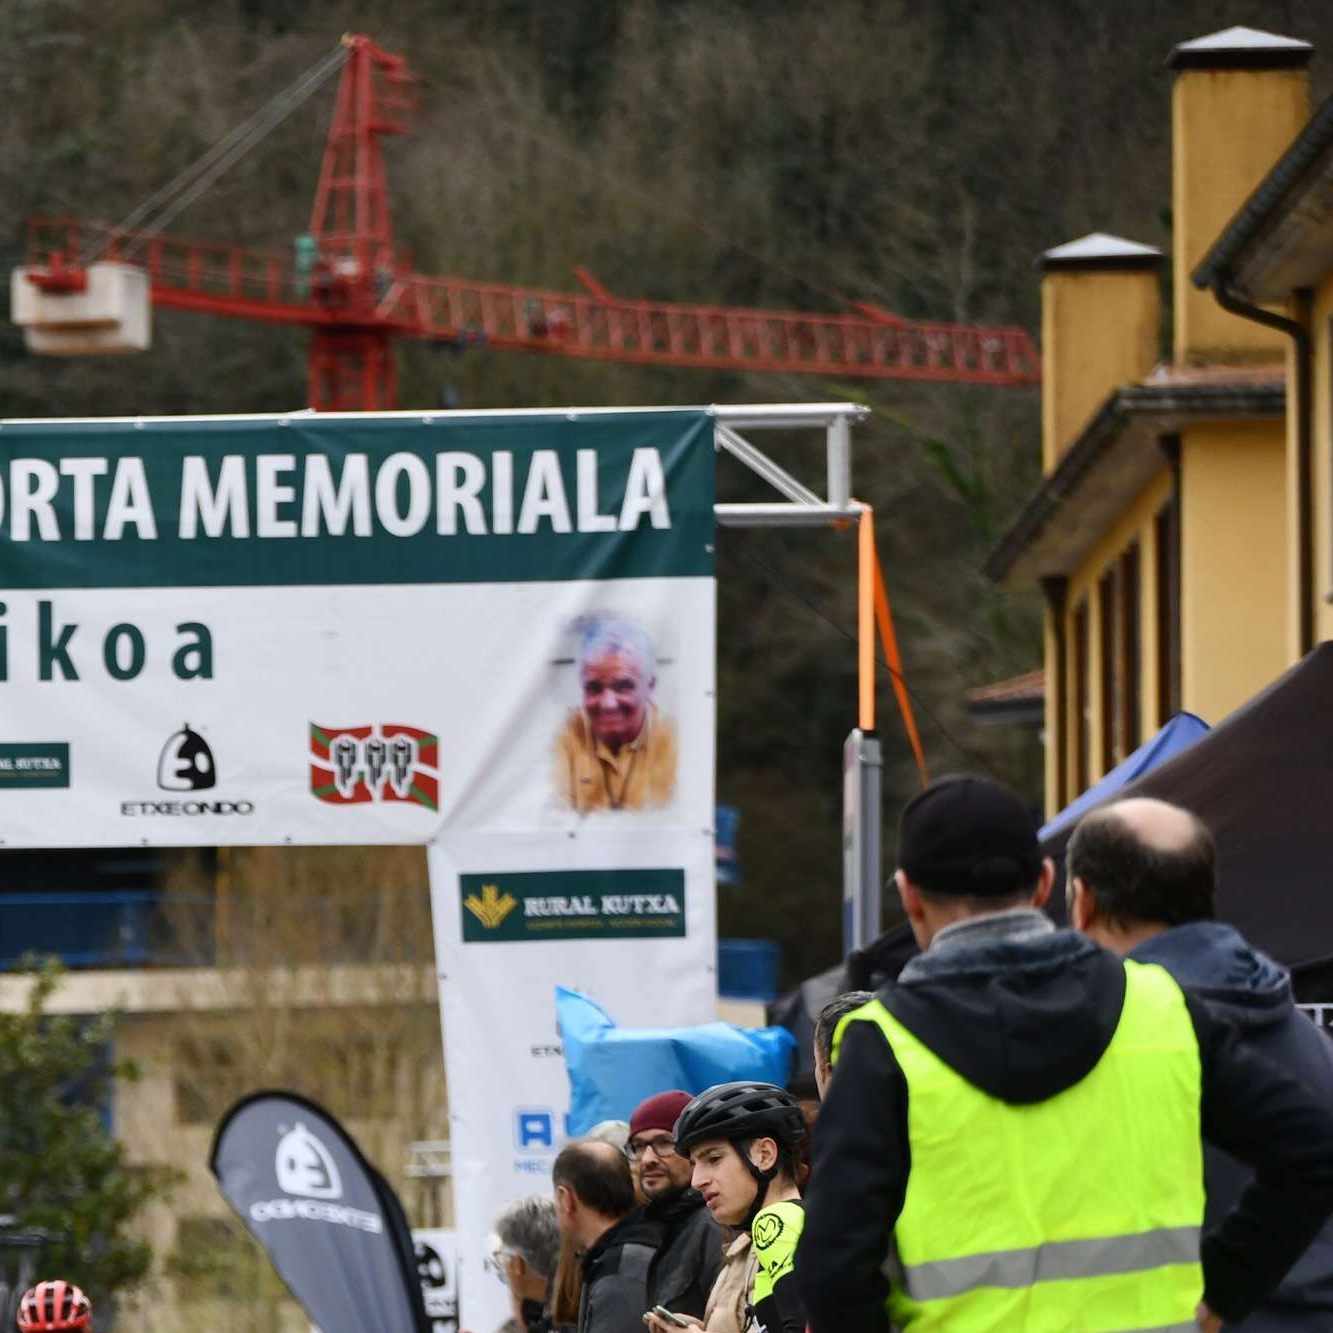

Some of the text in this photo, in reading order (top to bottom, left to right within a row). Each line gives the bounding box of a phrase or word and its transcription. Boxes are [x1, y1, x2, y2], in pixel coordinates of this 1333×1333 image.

[179, 449, 671, 539] MEMORIALA
[120, 801, 254, 816] ETXEONDO
[523, 894, 680, 917] RURAL KUTXA
